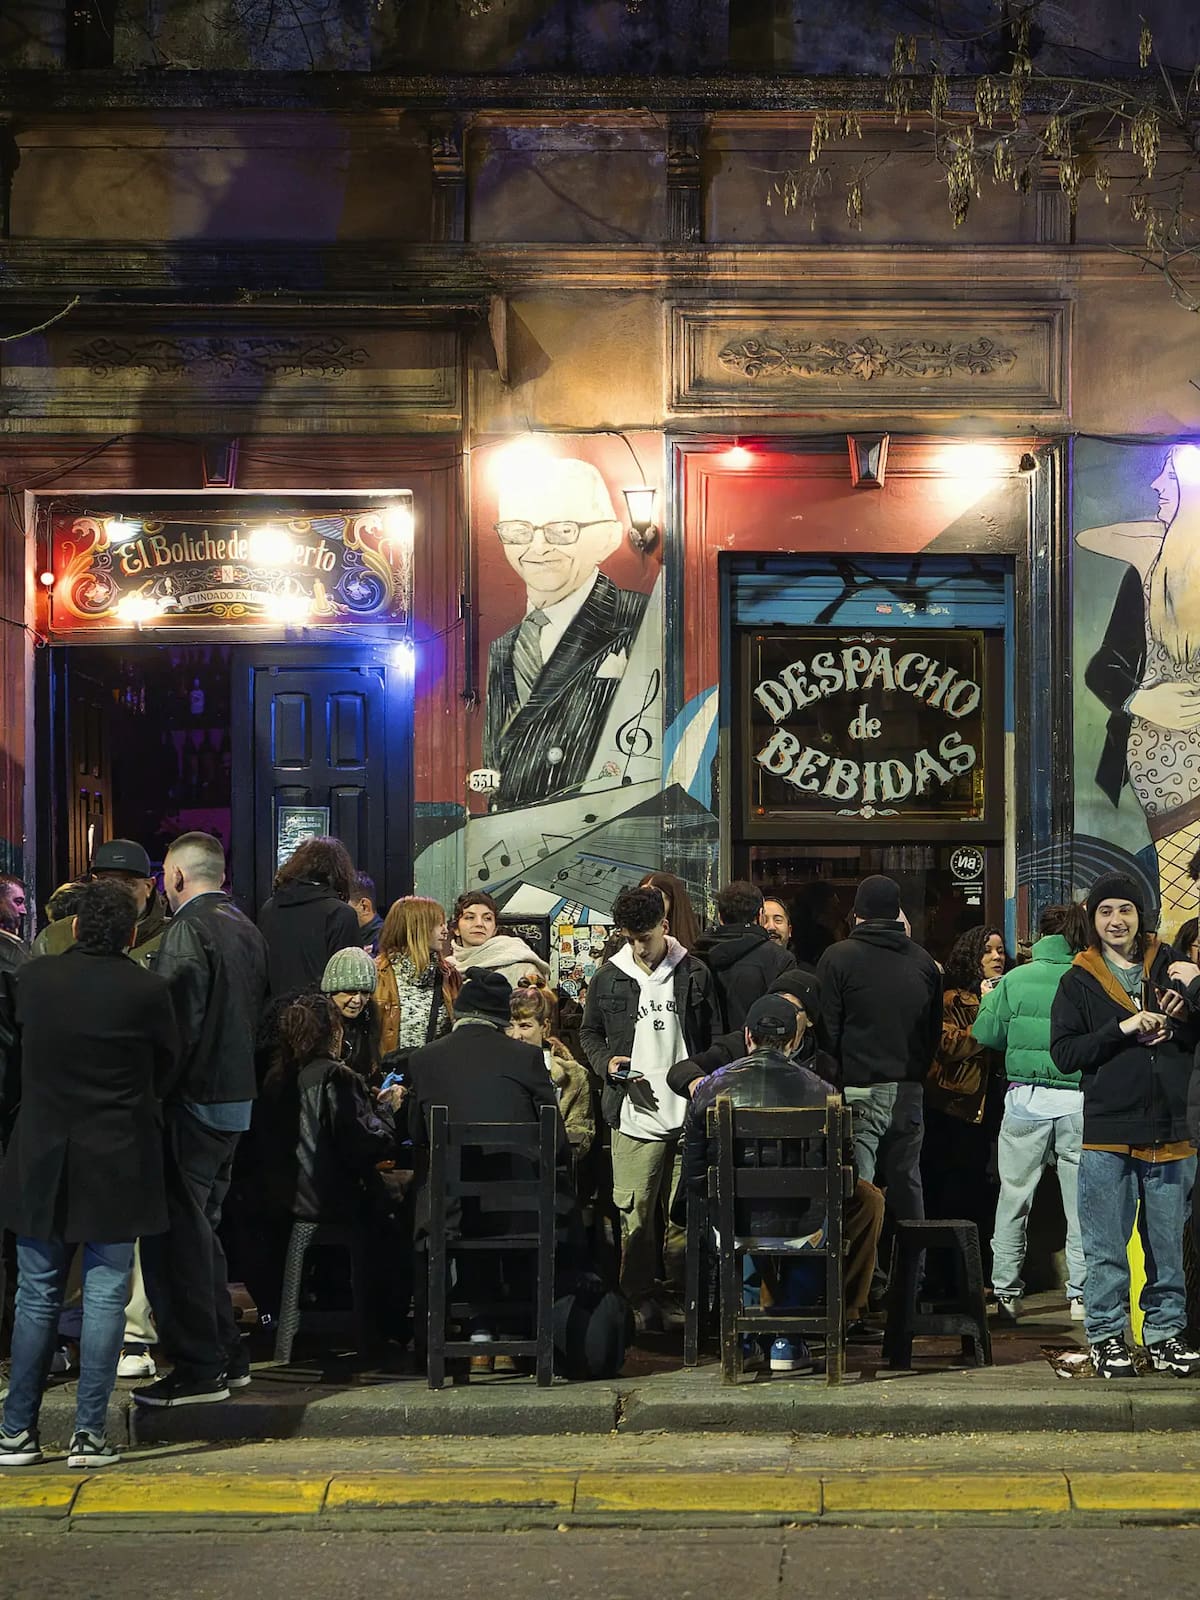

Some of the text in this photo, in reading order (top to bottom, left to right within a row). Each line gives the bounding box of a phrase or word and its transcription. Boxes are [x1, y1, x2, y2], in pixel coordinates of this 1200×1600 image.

[113, 537, 151, 576] El
[150, 529, 226, 567] Boliche
[228, 532, 248, 560] de
[188, 591, 234, 604] FUNDADO
[235, 591, 248, 600] EN
[753, 645, 981, 724] DESPACHO
[849, 703, 882, 740] de
[472, 773, 495, 789] 331
[752, 726, 977, 803] BEBIDAS
